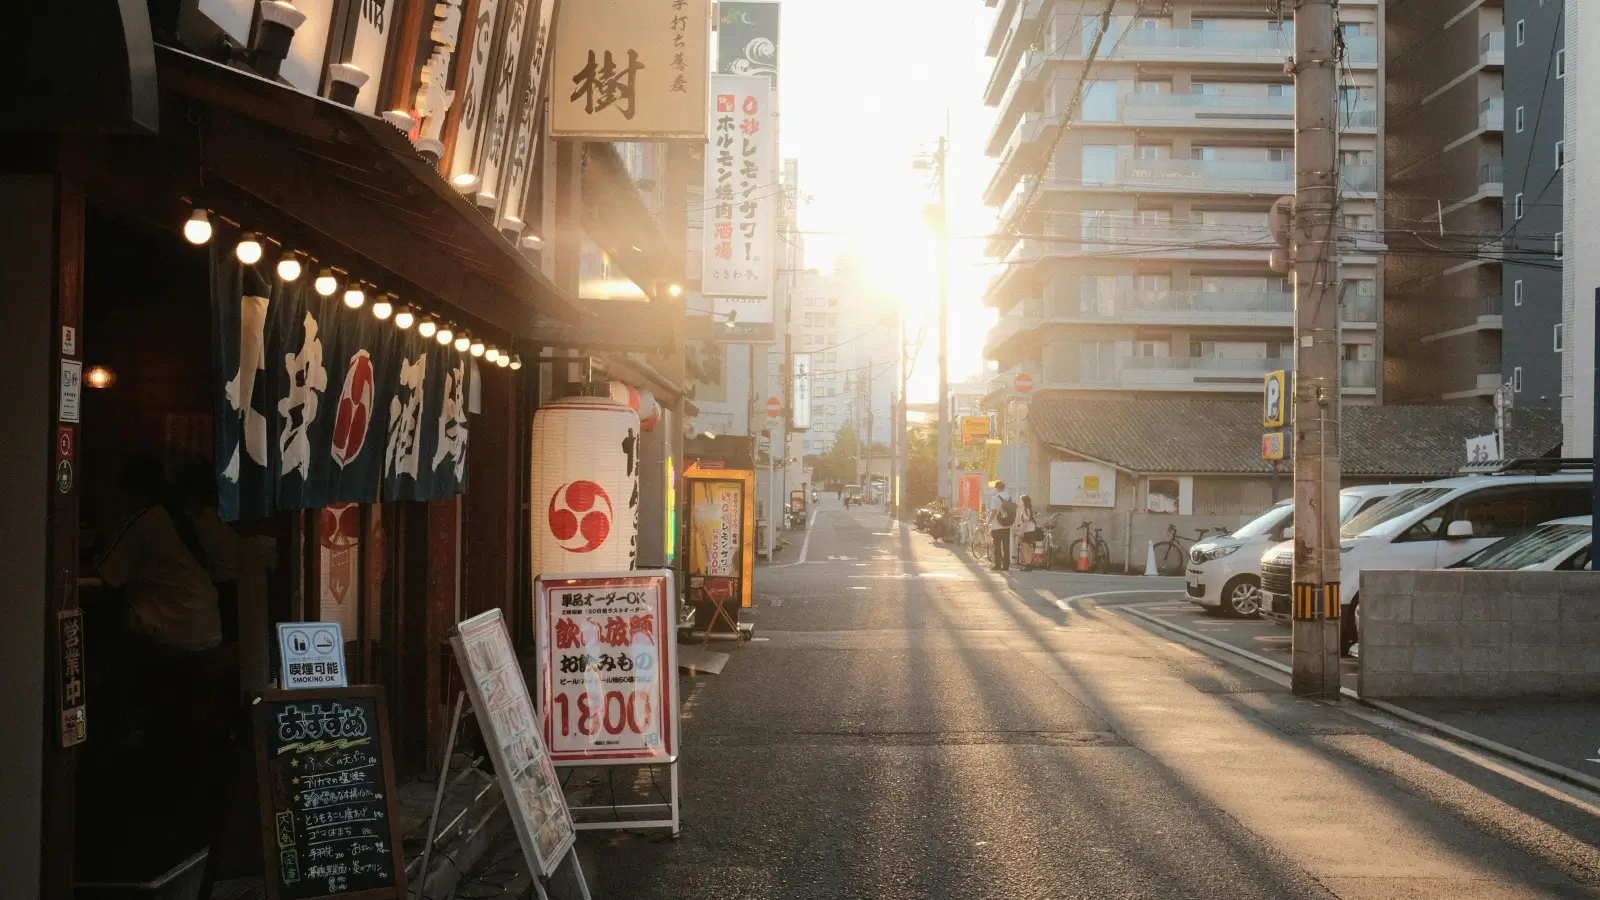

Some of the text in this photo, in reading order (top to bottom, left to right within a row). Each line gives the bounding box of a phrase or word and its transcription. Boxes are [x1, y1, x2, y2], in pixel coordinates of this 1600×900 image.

[570, 49, 645, 120] 樹
[561, 591, 646, 608] 単品オーダーOK
[64, 618, 81, 705] 営業中
[289, 662, 339, 676] 喫煙可能
[292, 676, 323, 684] SMOKING
[278, 703, 367, 741] おすすめ
[280, 813, 293, 844] 大人気
